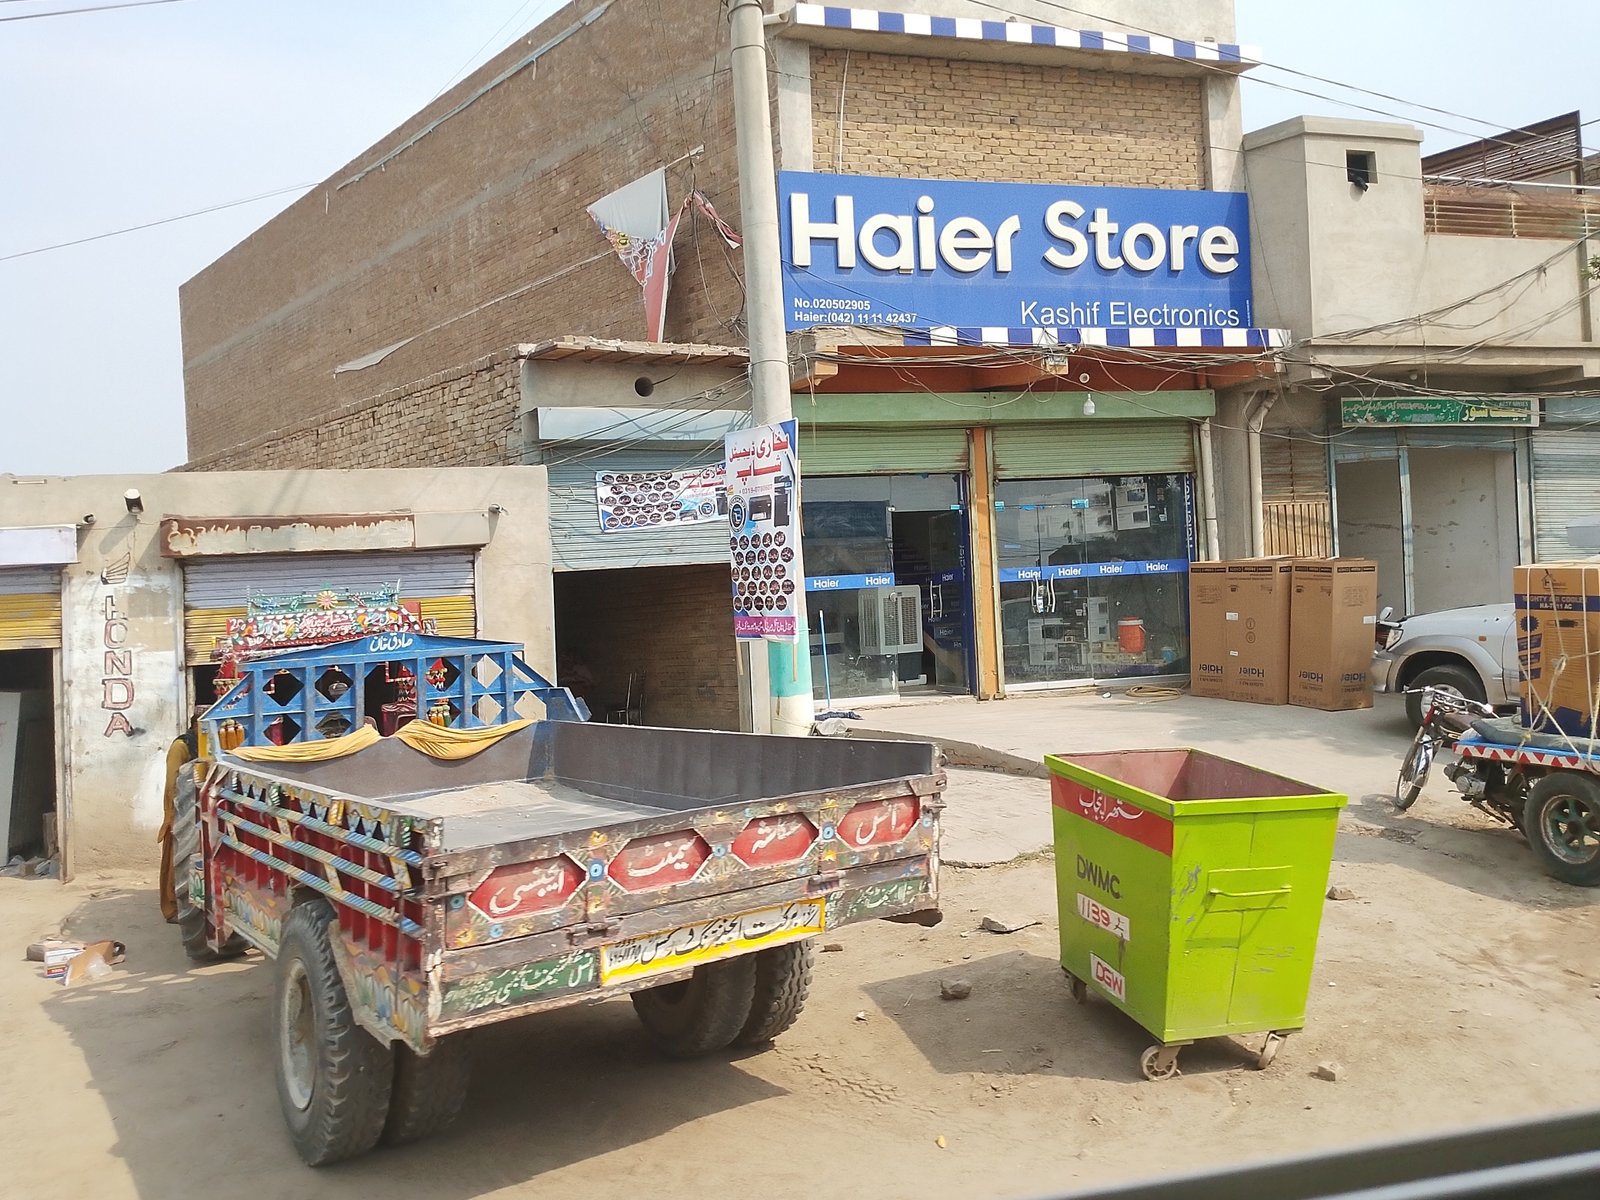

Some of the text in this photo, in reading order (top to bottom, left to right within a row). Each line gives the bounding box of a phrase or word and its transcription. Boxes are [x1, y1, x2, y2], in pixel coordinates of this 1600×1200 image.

[790, 192, 1240, 274] Haier Store
[794, 298, 870, 310] No.020502905
[1020, 300, 1100, 327] Kashif
[1110, 301, 1240, 328] Electronics
[729, 431, 789, 463] بخاری ڈیجیٹل
[736, 455, 782, 485] شاپ
[1018, 569, 1042, 580] Haier
[1058, 567, 1082, 577] Haier
[1099, 564, 1122, 574] Haier
[1146, 562, 1169, 572] Haier
[813, 579, 839, 589] Haier
[865, 576, 891, 587] Haier
[370, 633, 414, 652] صادق خان
[101, 595, 136, 738] HONDA
[1199, 664, 1223, 674] Haier
[1239, 667, 1265, 678] Haier
[1298, 671, 1324, 683] Haier
[1079, 788, 1144, 823] ستھرا پنجاب
[627, 836, 696, 878] سیمنٹ
[1077, 854, 1122, 900] DWMC
[488, 863, 566, 915] ایجنسی
[1081, 894, 1111, 928] 1139
